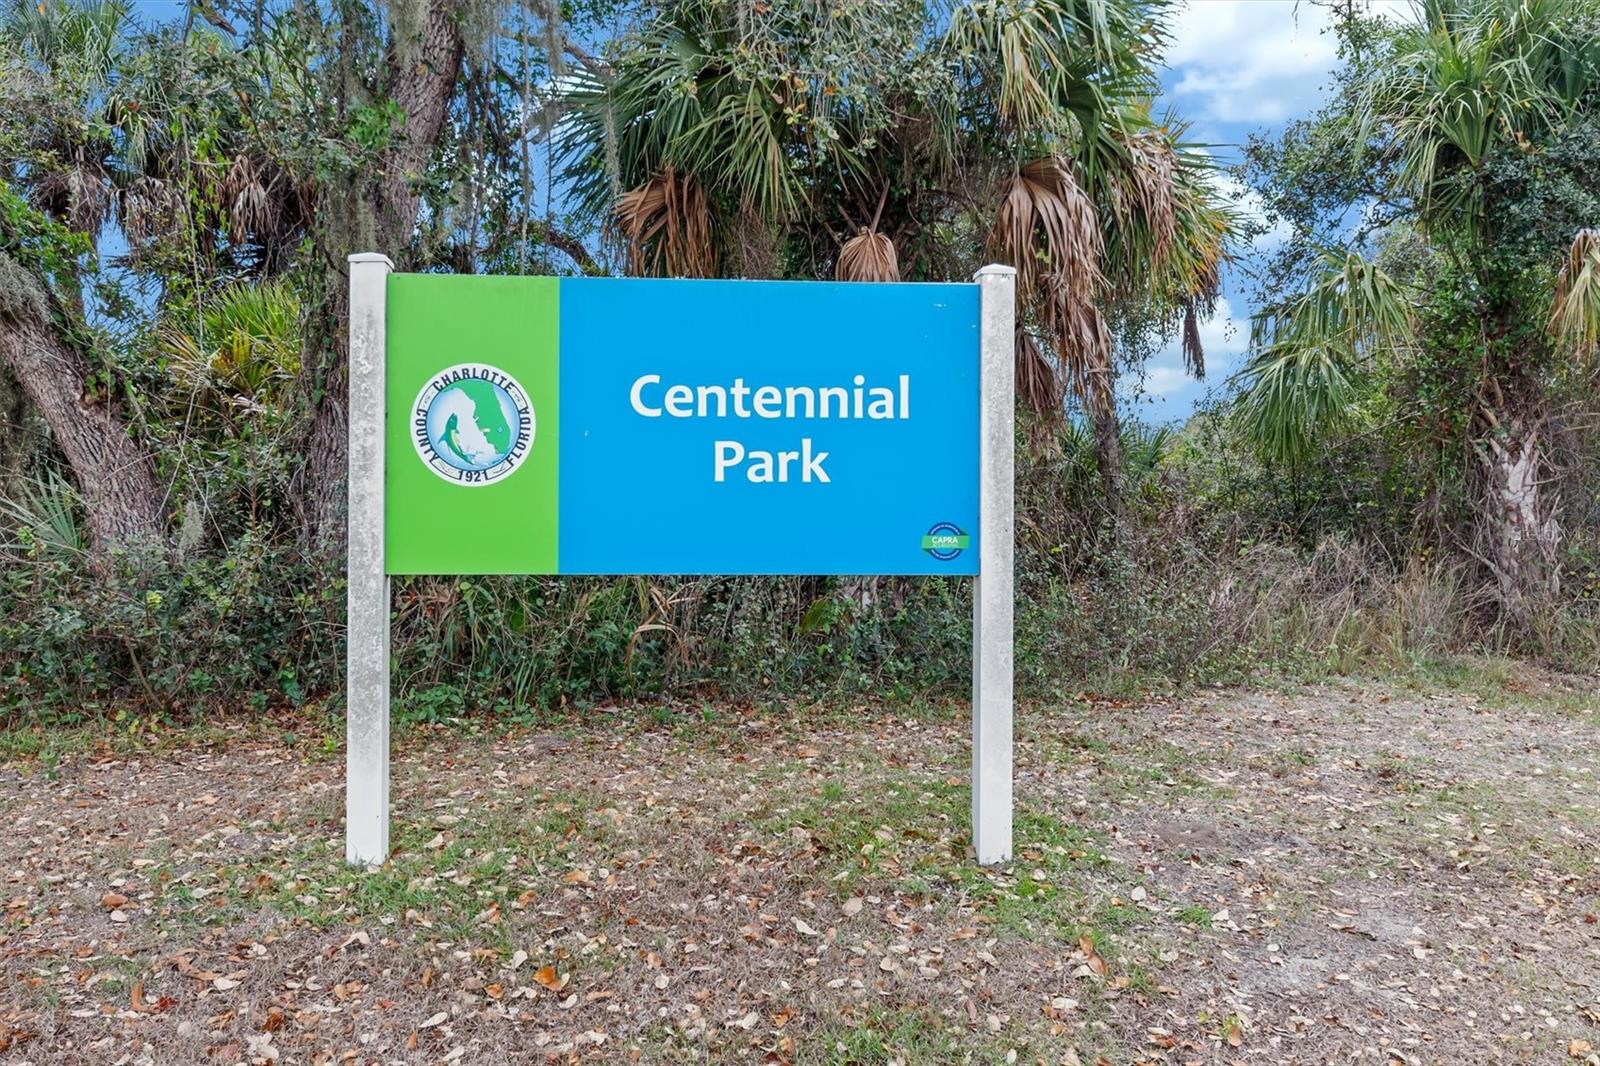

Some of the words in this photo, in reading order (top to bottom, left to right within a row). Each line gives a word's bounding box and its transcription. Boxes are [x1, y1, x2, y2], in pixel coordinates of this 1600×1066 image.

[433, 367, 515, 391] CHARLOTTE
[630, 374, 909, 420] Centennial
[415, 408, 439, 462] COUNTY
[507, 406, 531, 466] FLORIDA
[458, 470, 489, 482] 1921
[714, 438, 831, 483] Park
[931, 536, 959, 544] CAPRA
